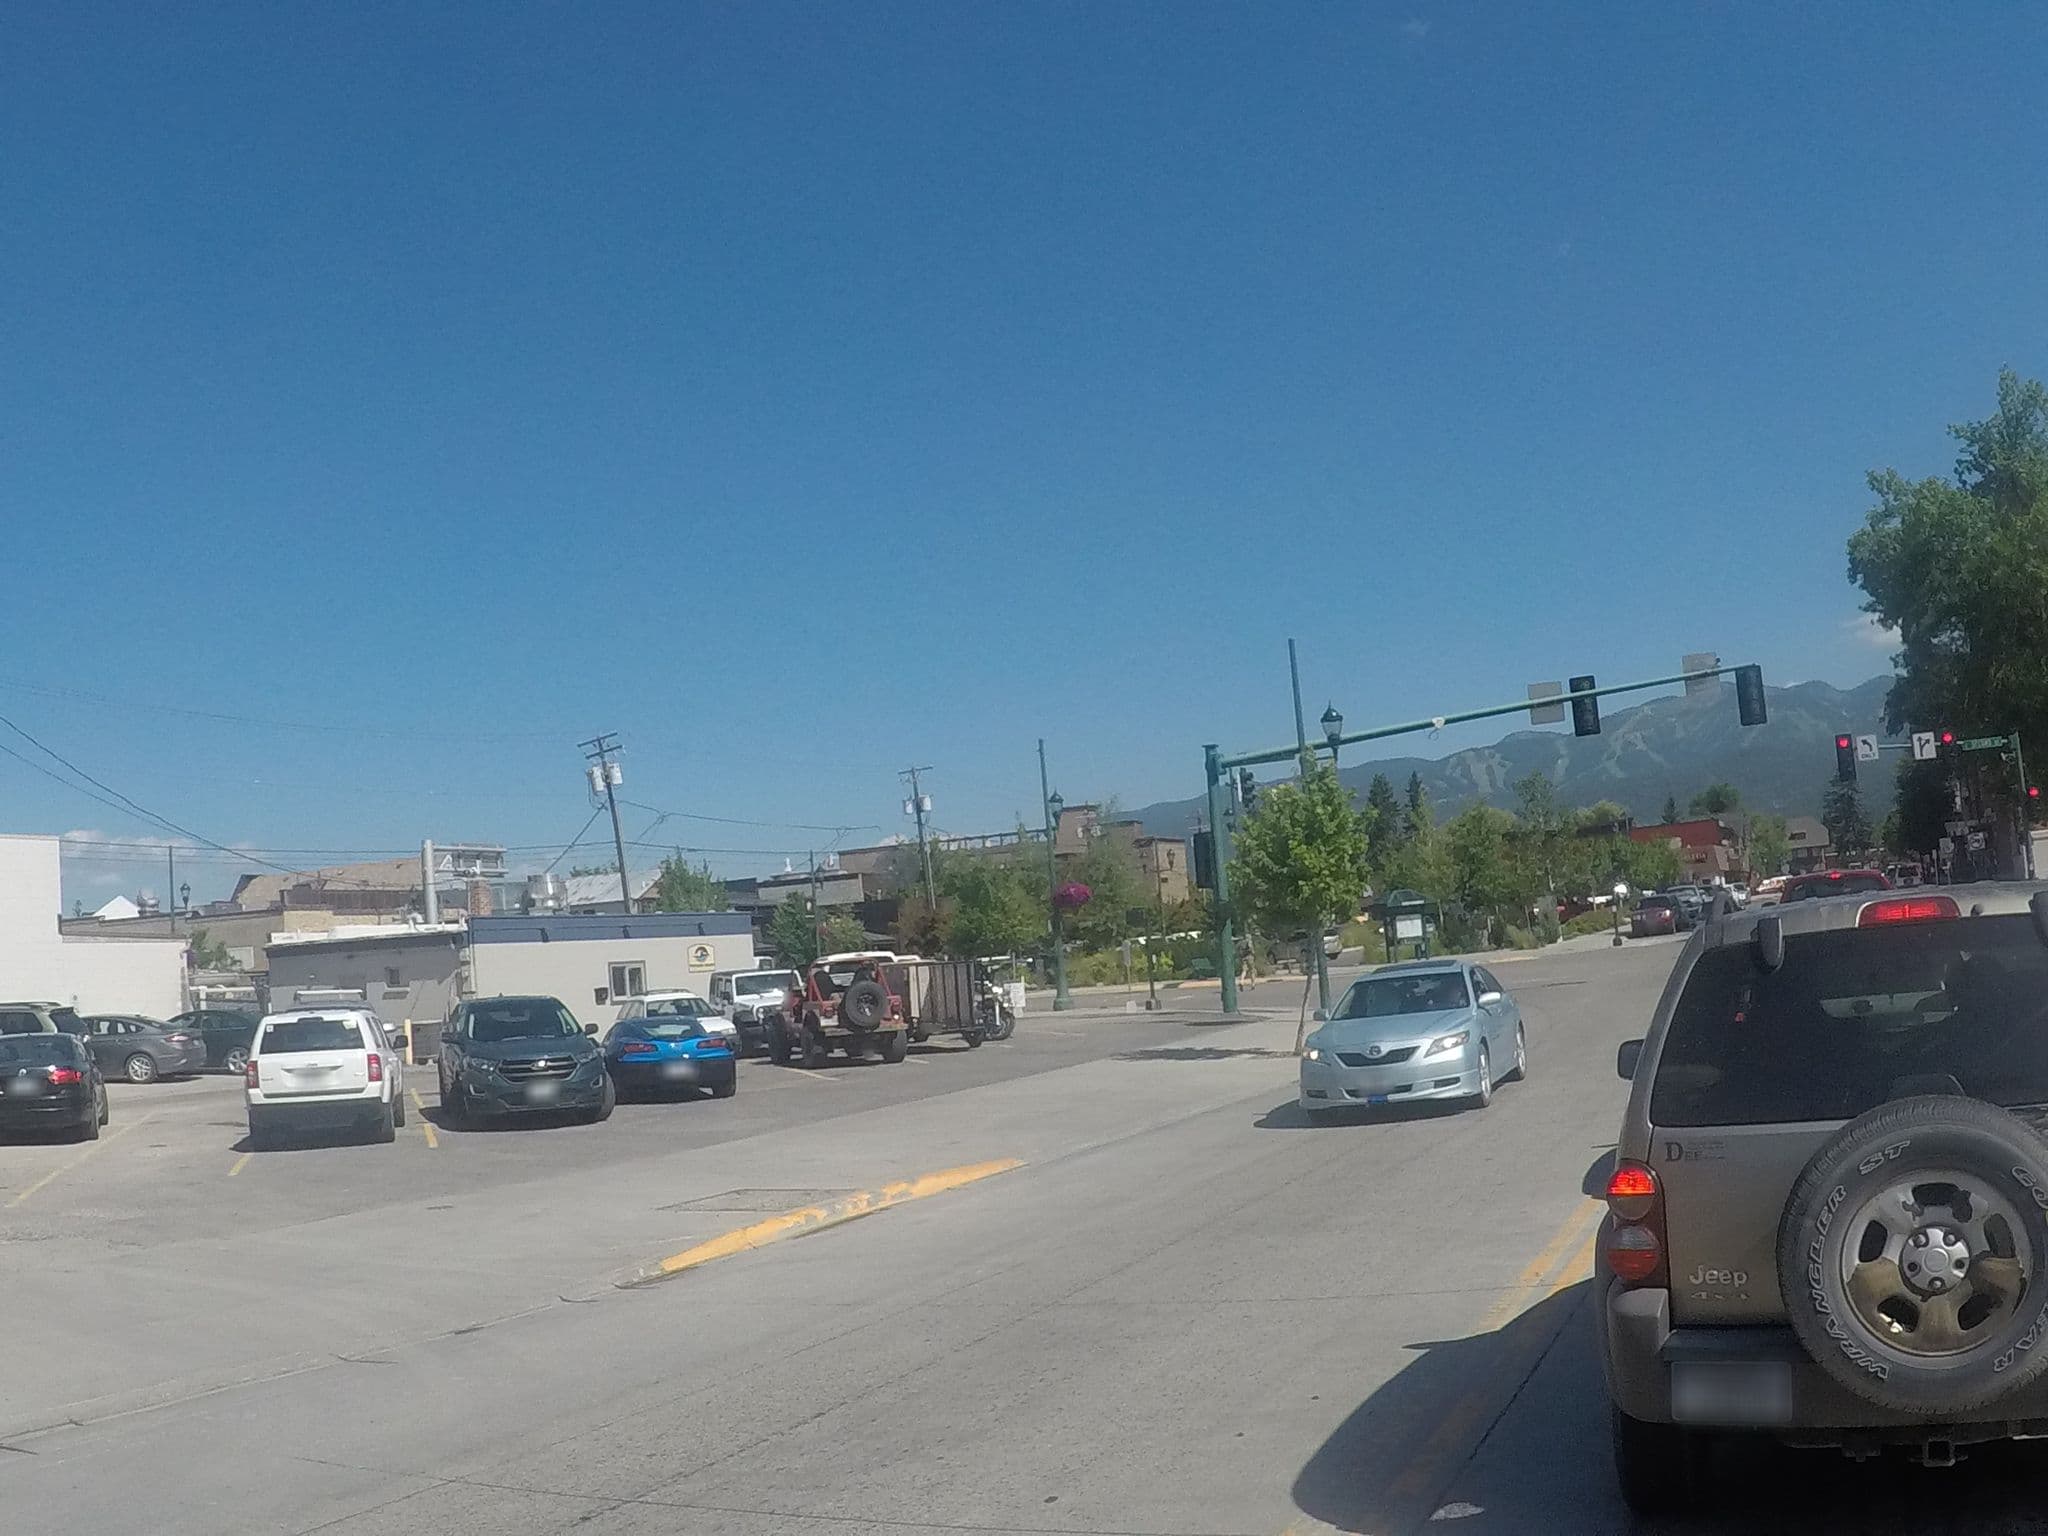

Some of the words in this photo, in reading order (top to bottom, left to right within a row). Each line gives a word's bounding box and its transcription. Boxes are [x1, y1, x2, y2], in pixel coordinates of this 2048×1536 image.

[1858, 1141, 1911, 1175] ST
[1688, 1264, 1748, 1288] Jeep
[1808, 1184, 1890, 1381] WRANGLER
